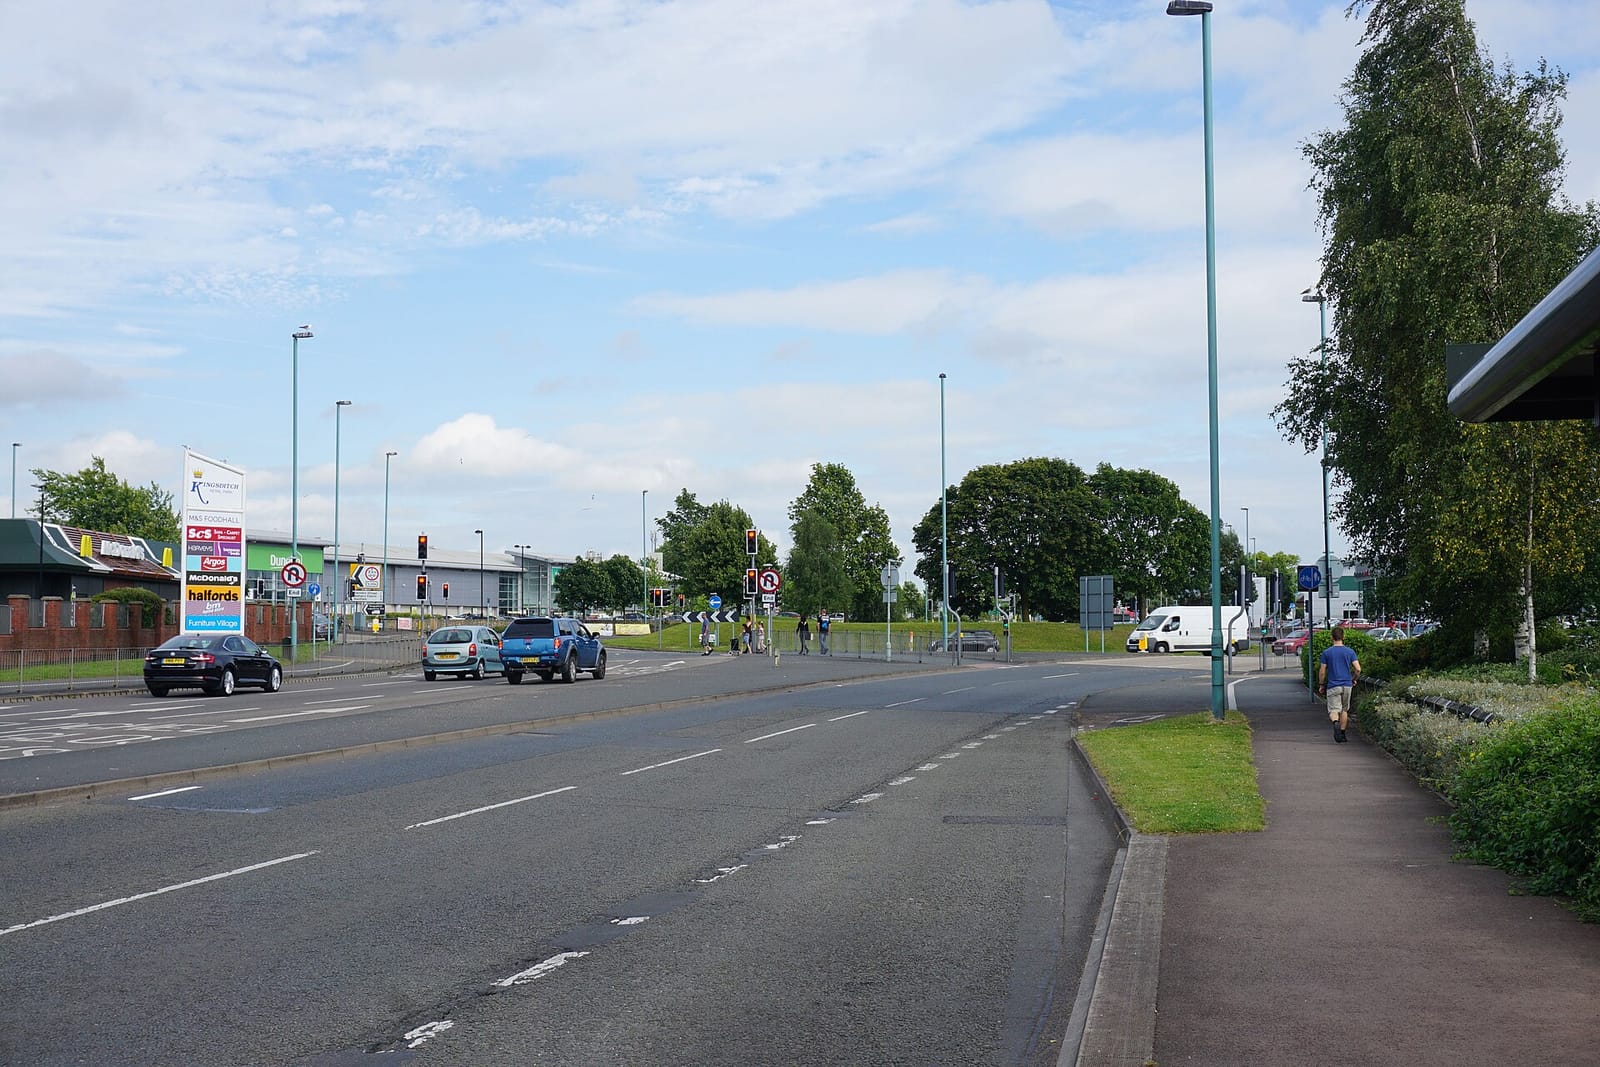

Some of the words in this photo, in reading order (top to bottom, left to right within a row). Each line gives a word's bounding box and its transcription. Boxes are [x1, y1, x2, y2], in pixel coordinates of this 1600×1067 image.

[204, 516, 240, 524] FOODHALL
[203, 557, 226, 568] Argos
[188, 574, 238, 585] McDonald's
[188, 590, 238, 601] halfords
[216, 620, 238, 628] Village
